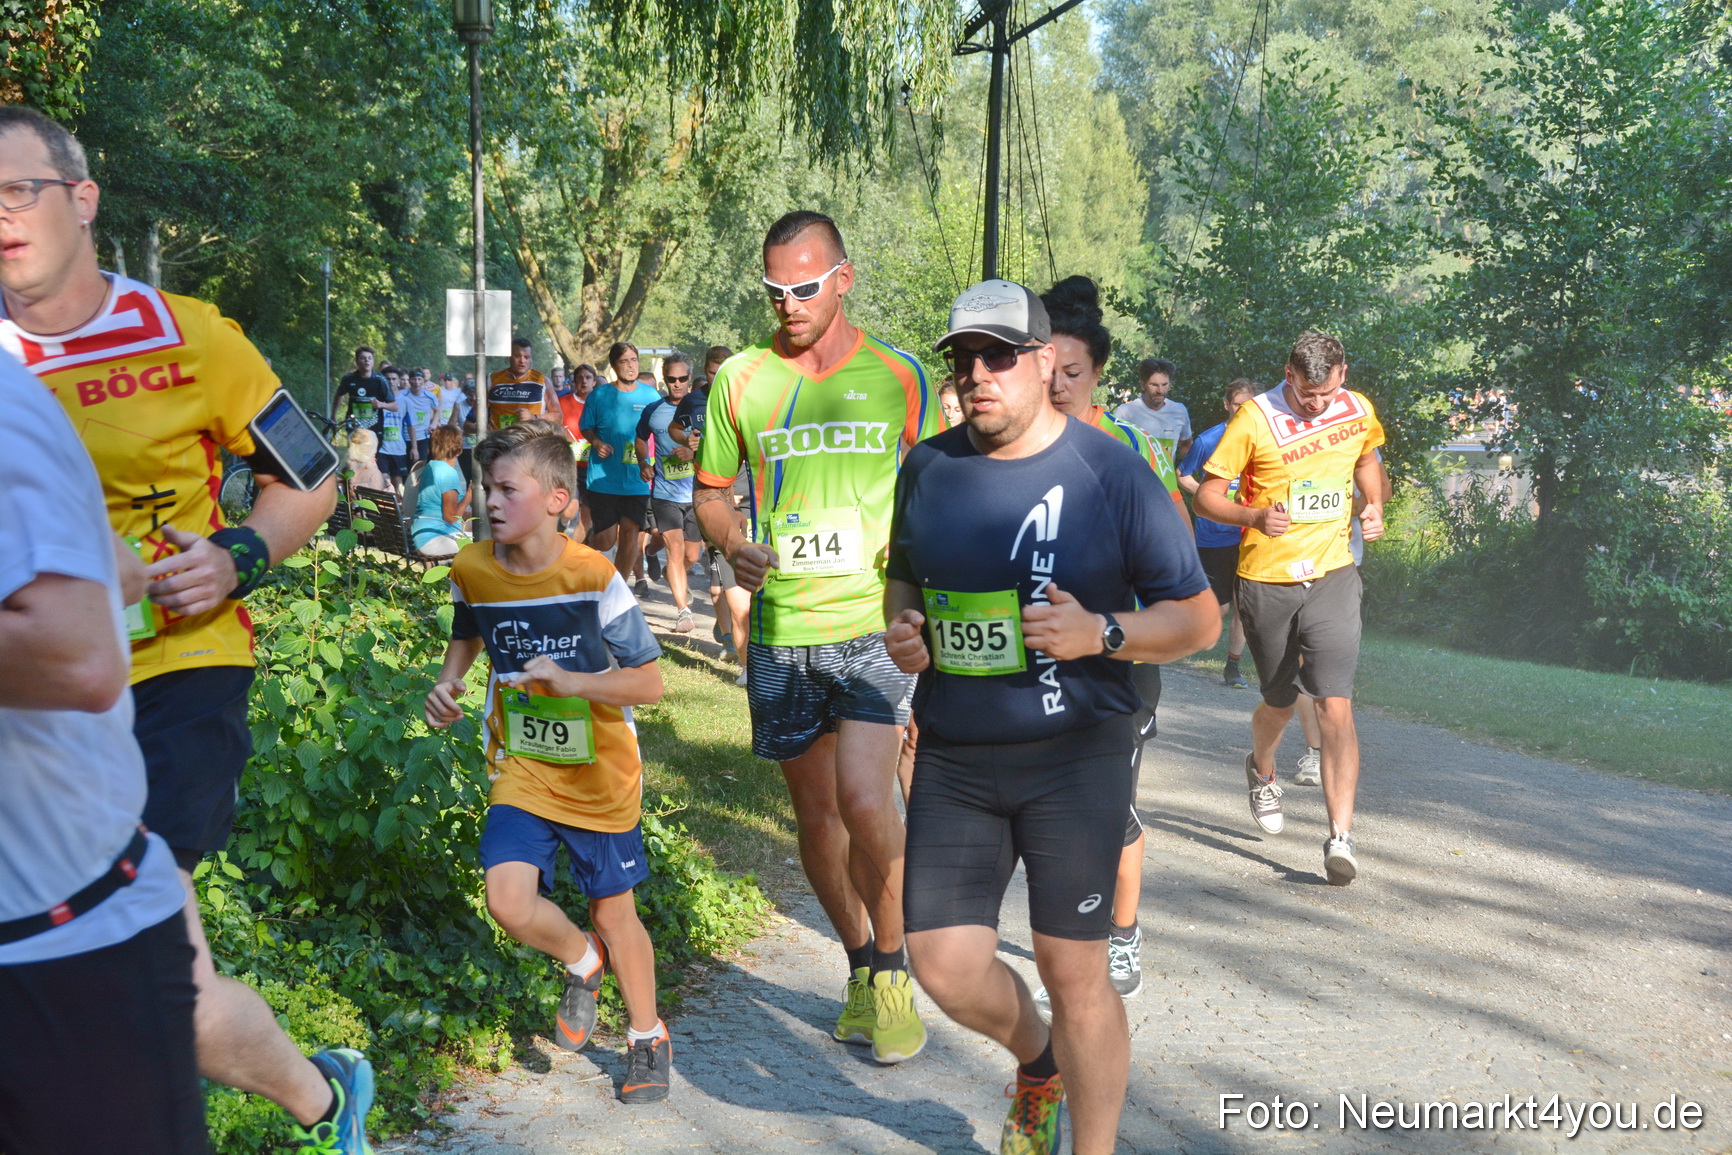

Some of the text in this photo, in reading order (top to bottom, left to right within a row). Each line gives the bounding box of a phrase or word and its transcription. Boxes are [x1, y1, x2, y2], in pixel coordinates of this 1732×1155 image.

[76, 362, 196, 408] BÖGL
[499, 389, 531, 397] Fischer
[757, 421, 889, 462] BOCK
[1281, 421, 1368, 466] MAX BÖGL
[666, 463, 690, 473] 1762
[1298, 492, 1340, 510] 1260
[791, 532, 842, 559] 214
[791, 559, 831, 567] Zimmerman
[505, 634, 582, 652] Fischer
[935, 619, 1008, 652] 1595
[516, 649, 577, 660] AUTOOBILE
[940, 650, 1006, 661] Schrenk Christian
[523, 715, 569, 745] 579
[555, 745, 577, 753] Fabio
